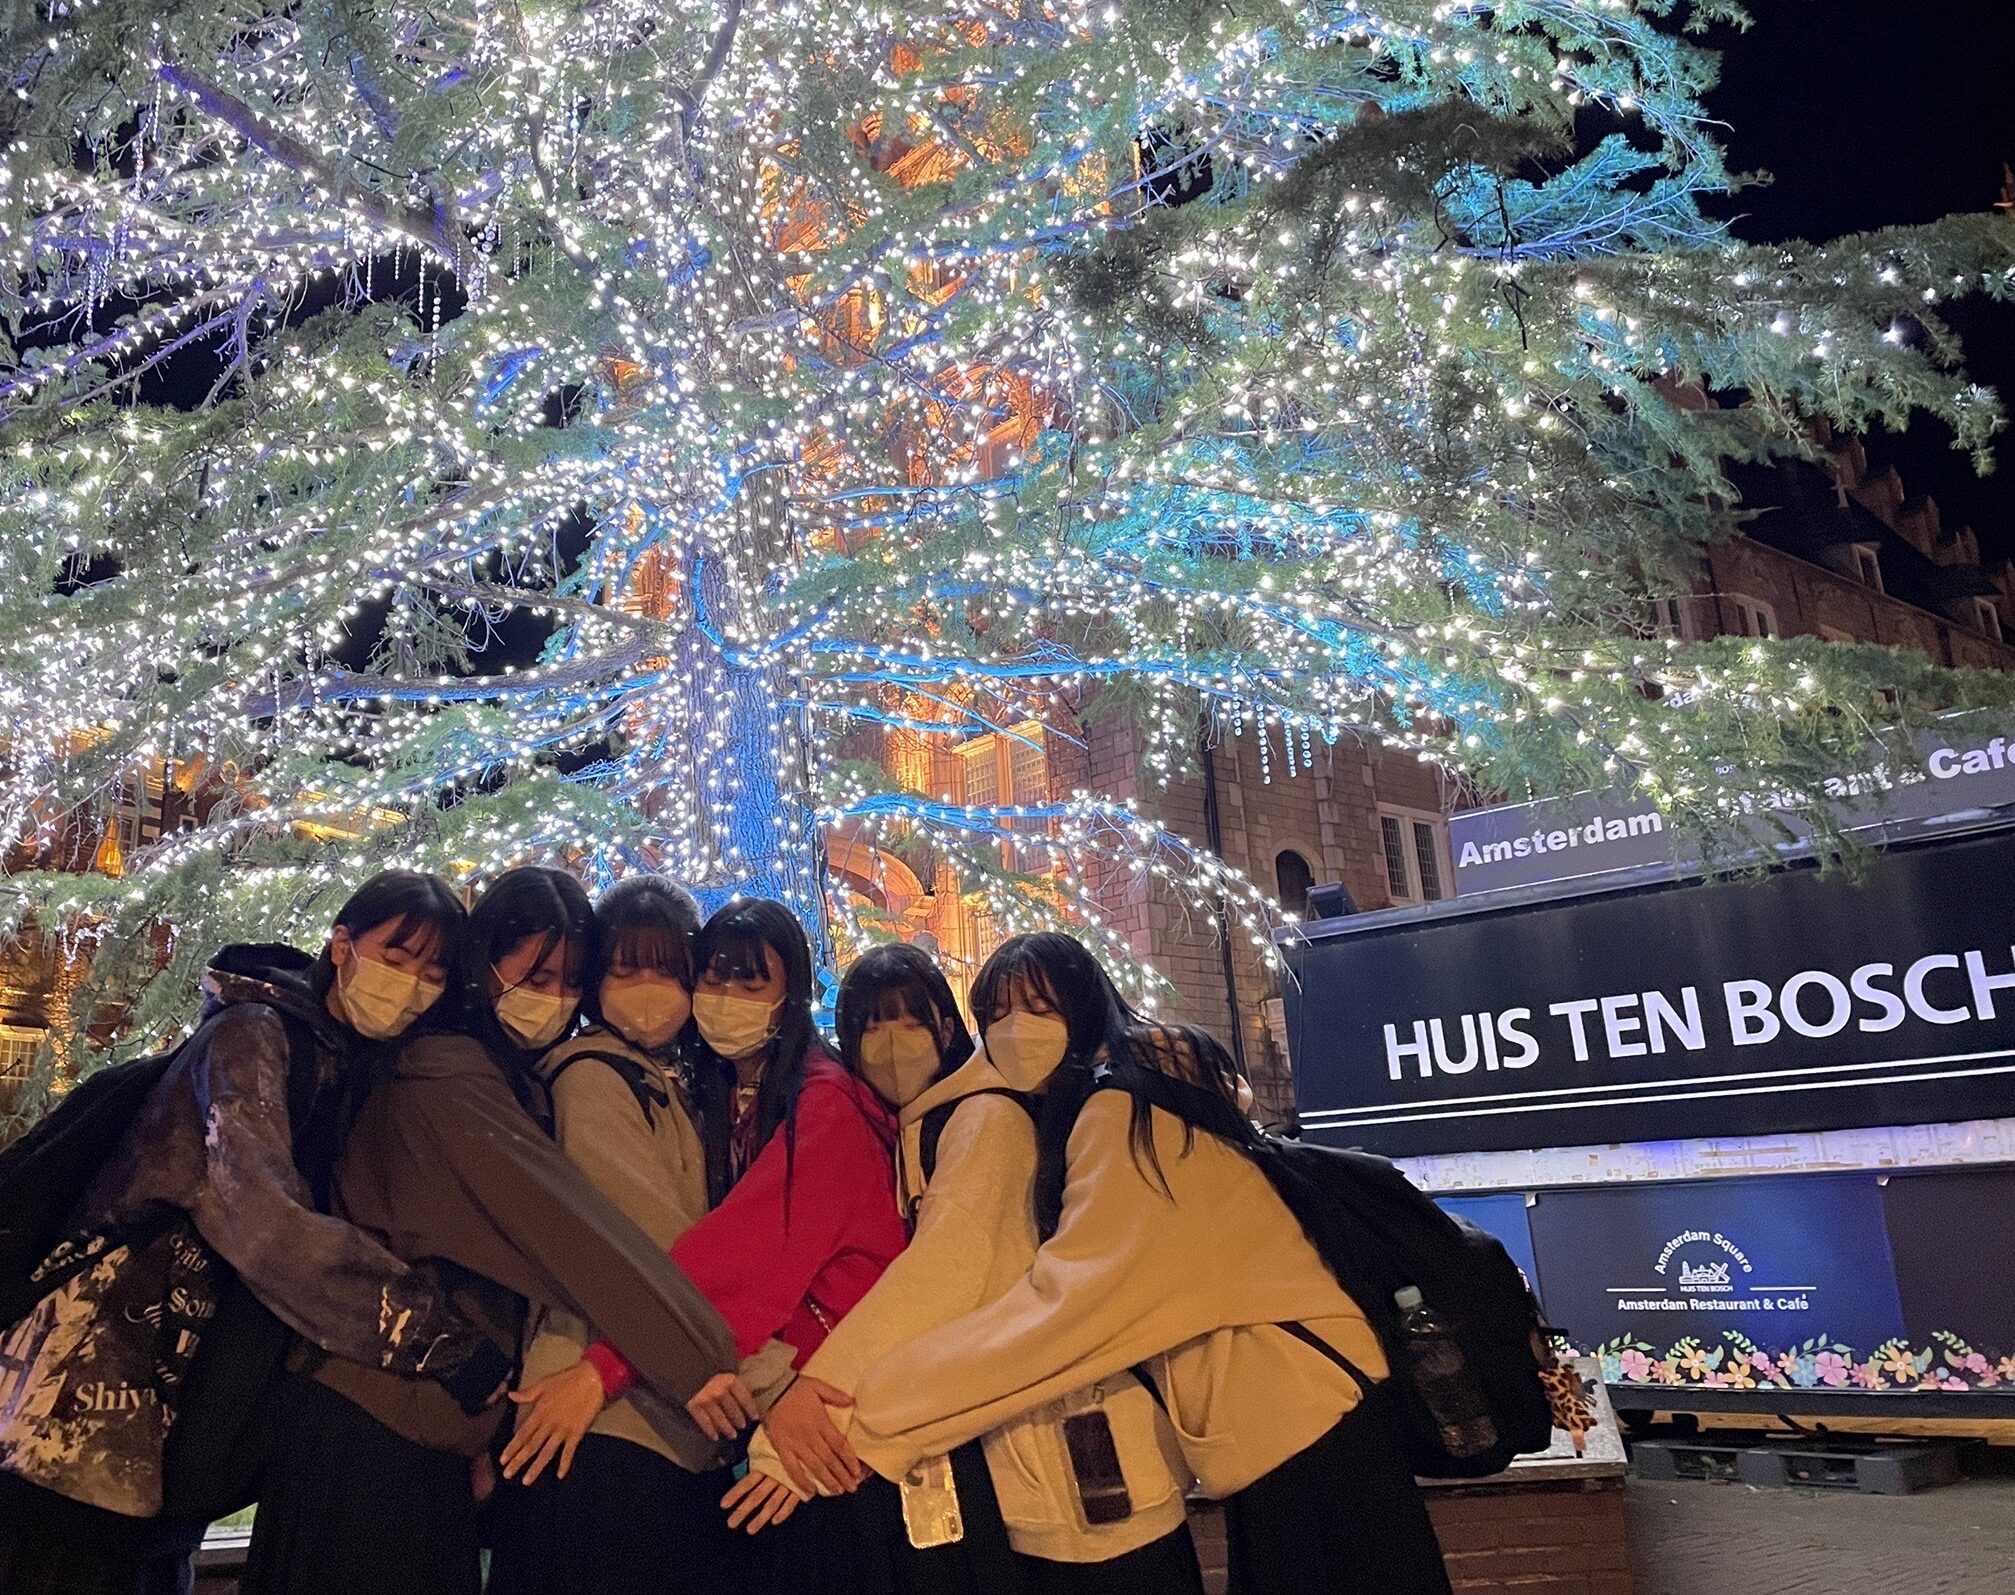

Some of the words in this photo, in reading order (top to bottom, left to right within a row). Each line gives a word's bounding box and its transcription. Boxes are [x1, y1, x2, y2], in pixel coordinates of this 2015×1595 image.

[1458, 811, 1663, 869] Amsterdam
[1383, 1007, 1540, 1081] HUIS
[1548, 986, 1706, 1062] TEN
[1654, 1229, 1711, 1275] Amsterdam
[1712, 1232, 1753, 1273] Square
[1617, 1298, 1688, 1311] Amsterdam
[1689, 1298, 1761, 1311] Restaurant
[1763, 1298, 1775, 1311] &
[1777, 1293, 1810, 1311] Café
